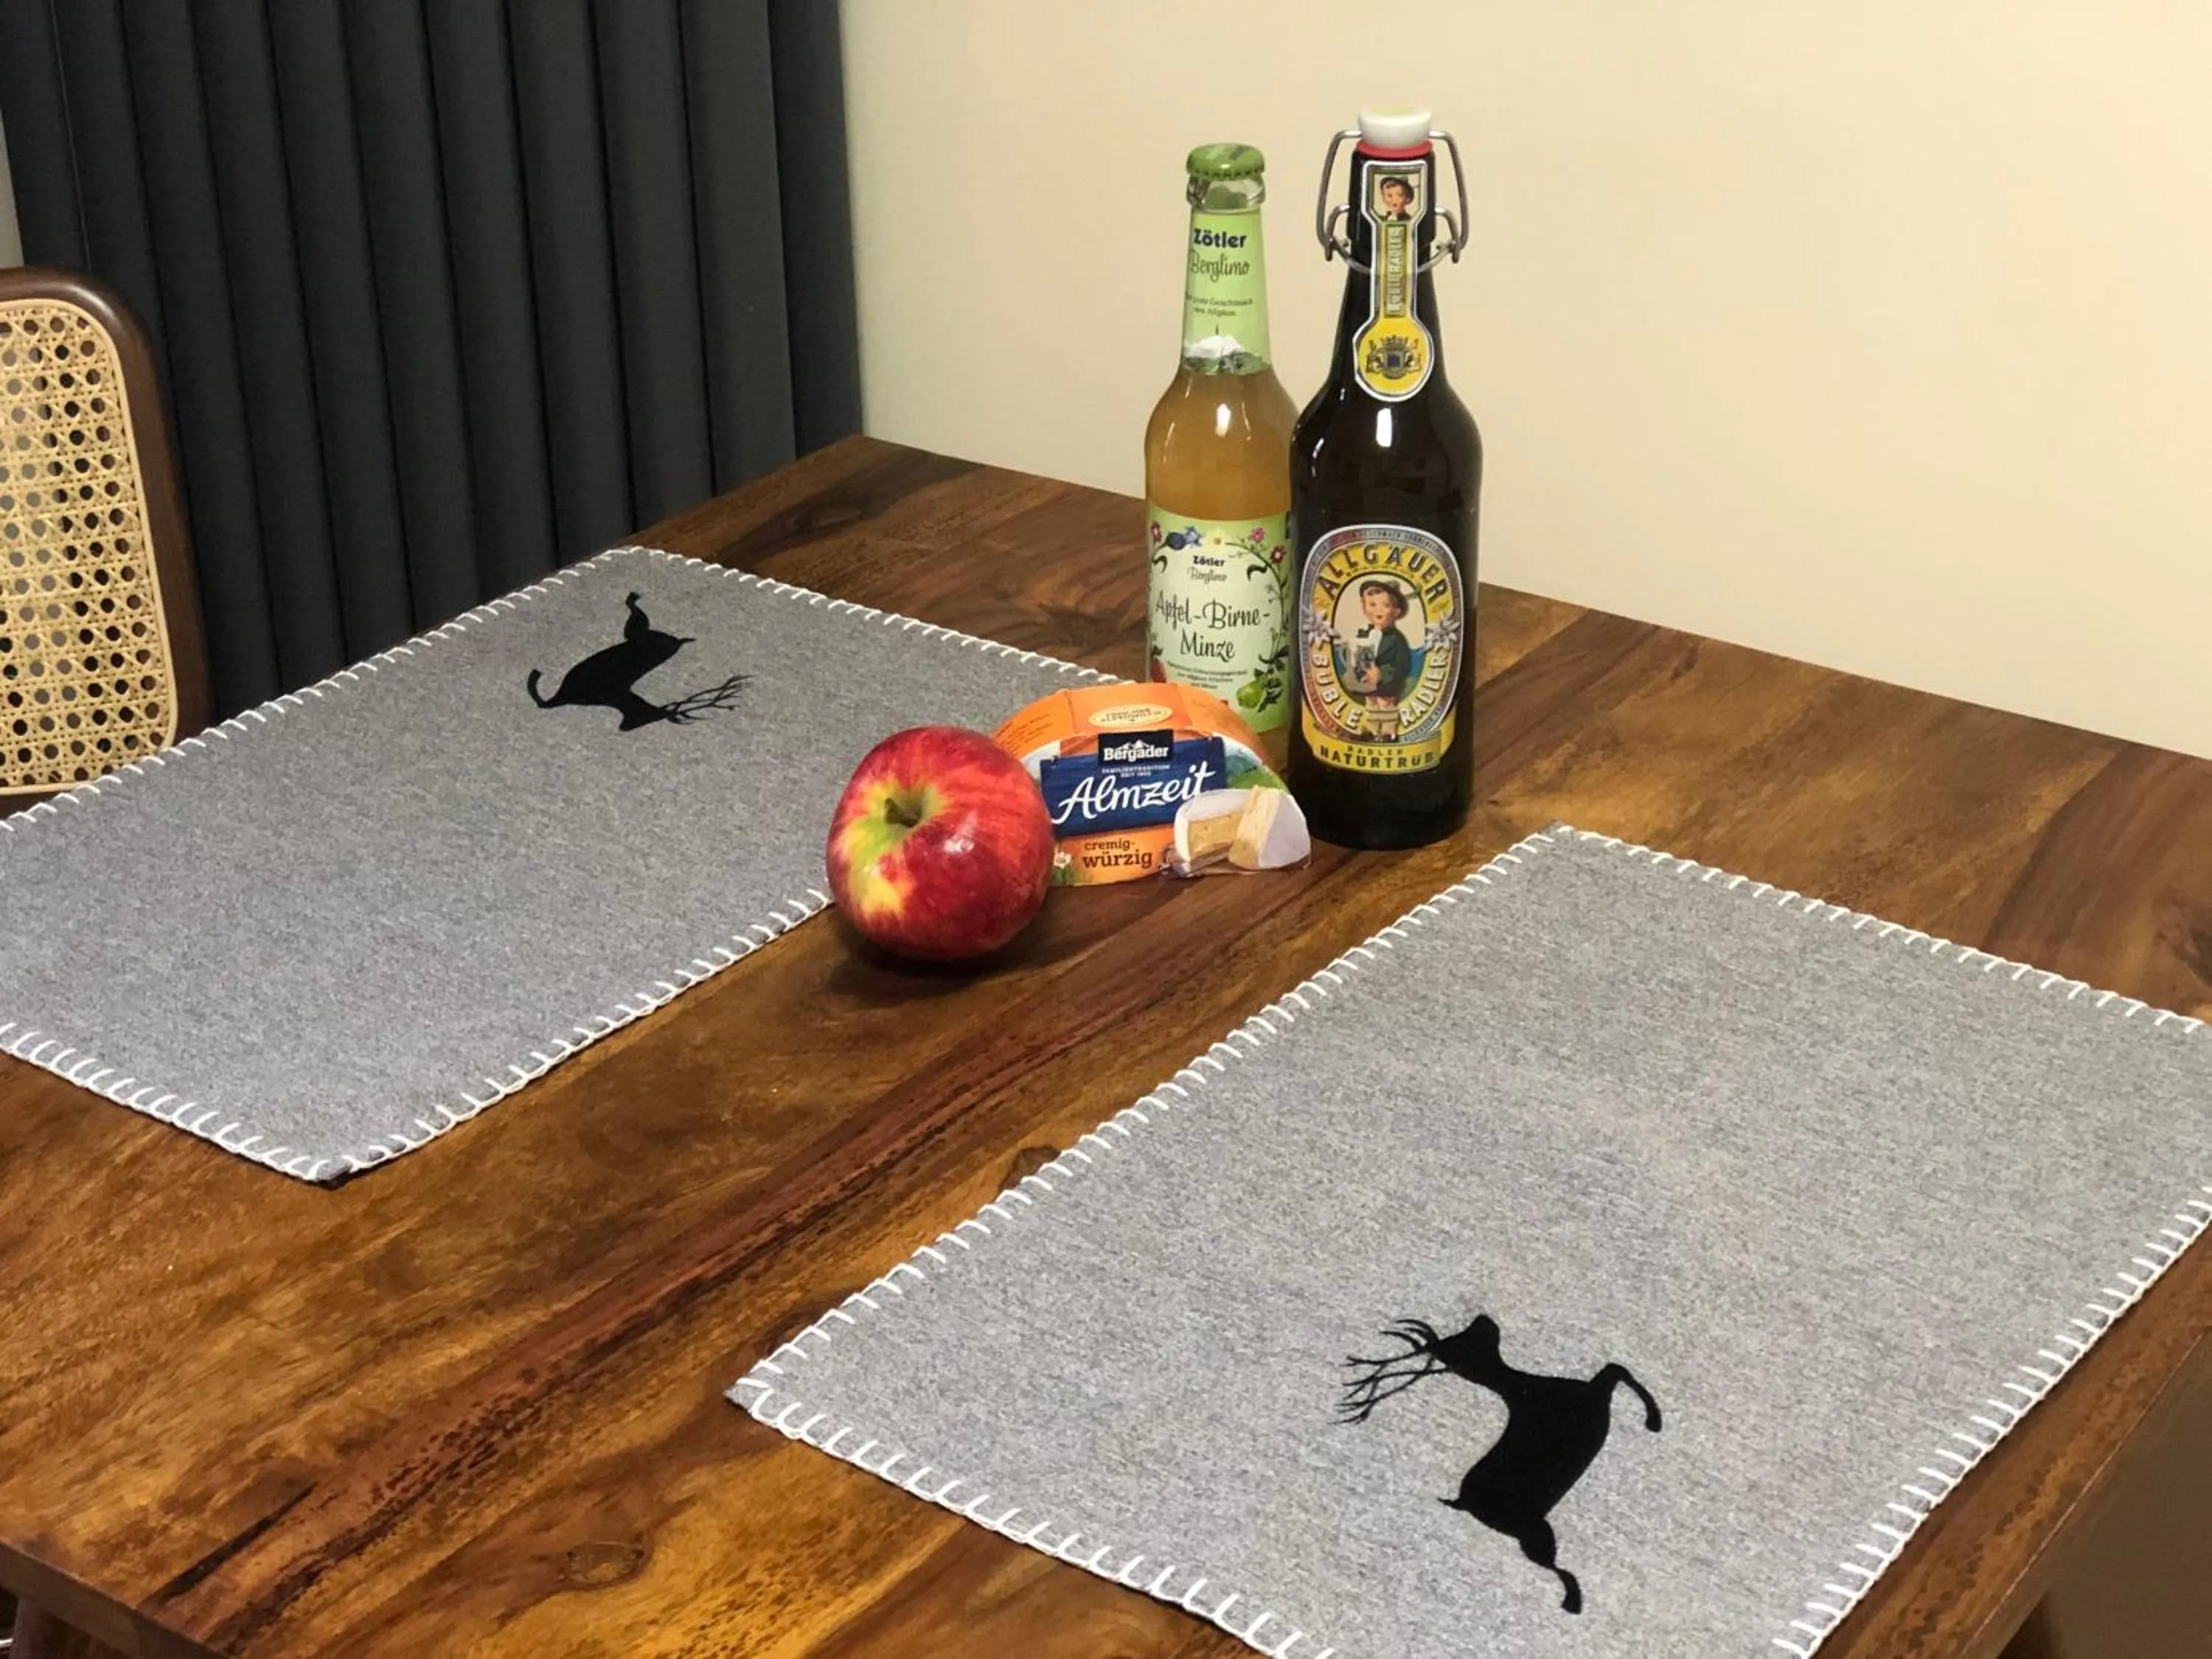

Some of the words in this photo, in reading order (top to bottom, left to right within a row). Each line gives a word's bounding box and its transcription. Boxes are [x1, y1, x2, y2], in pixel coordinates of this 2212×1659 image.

[1194, 227, 1247, 248] Zötler
[1189, 248, 1251, 283] Berglimo
[1193, 555, 1225, 567] Zötler
[1318, 543, 1447, 605] ALLGÄUER
[1180, 628, 1235, 663] Minze
[1399, 651, 1448, 728] RADLER
[1103, 744, 1169, 762] Bergader
[1051, 760, 1216, 824] Almzeit
[1082, 848, 1152, 869] würzig
